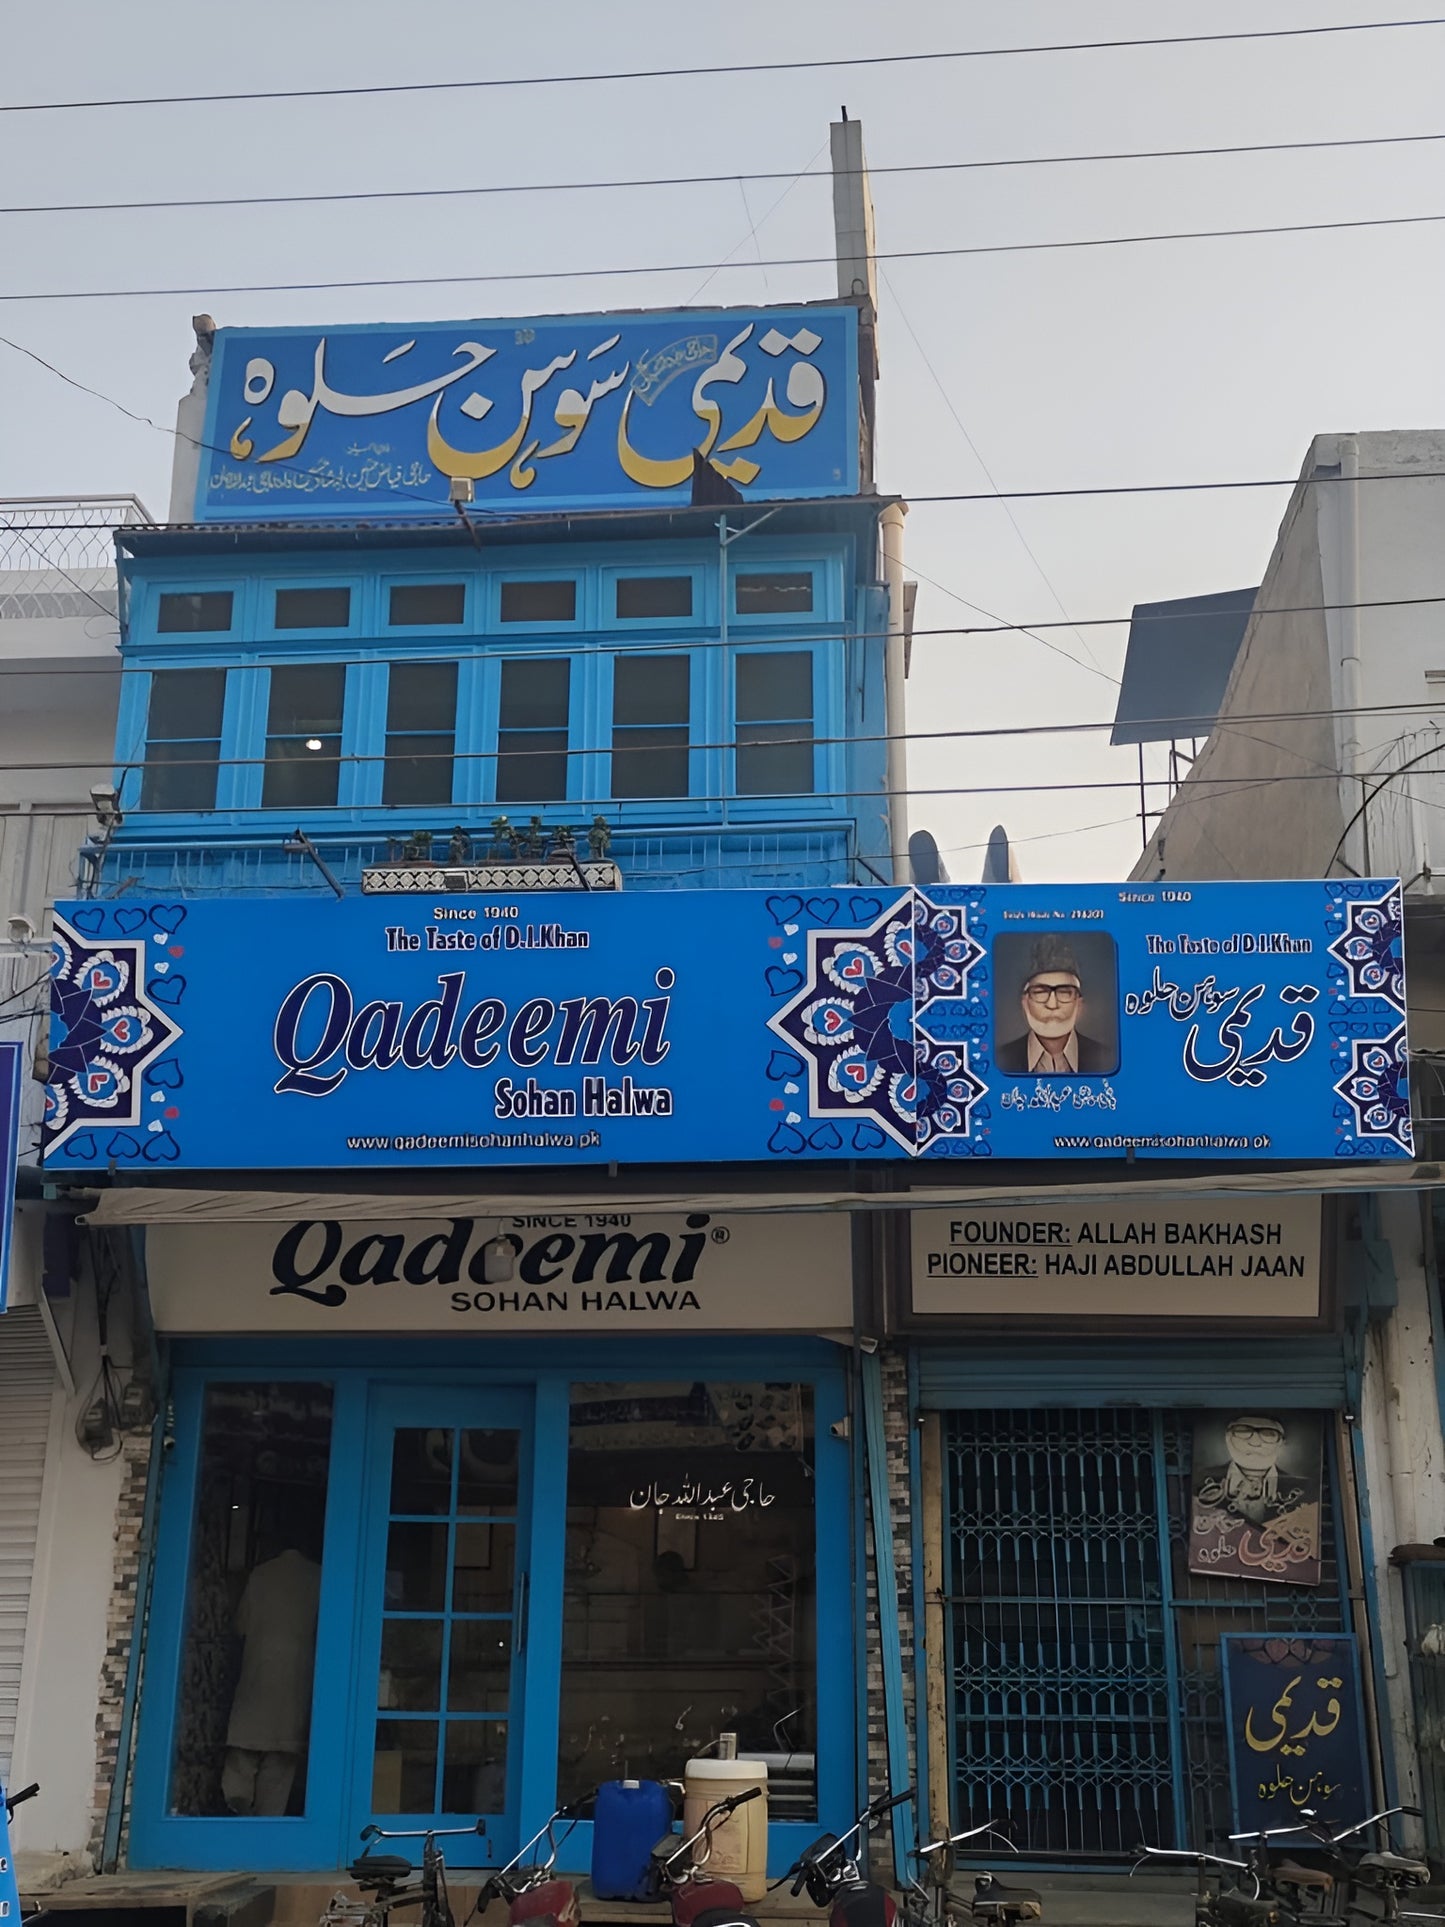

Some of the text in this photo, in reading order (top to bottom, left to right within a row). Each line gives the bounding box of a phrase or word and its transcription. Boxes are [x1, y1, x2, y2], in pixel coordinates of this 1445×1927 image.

[618, 322, 824, 489] قدیمی
[433, 906, 519, 919] Since 1940
[385, 924, 590, 951] The Taste of D.I.Khan
[1146, 934, 1175, 954] The
[1178, 934, 1220, 954] Taste
[1222, 934, 1239, 954] of
[1125, 966, 1179, 1015] حلوہ
[273, 967, 676, 1097] Qadeemi
[1183, 983, 1321, 1088] قدیمی
[494, 1076, 673, 1119] Sohan Halwa
[512, 1213, 631, 1228] SINCE 1940
[949, 1221, 1282, 1246] FOUNDER: ALLAH BAKHASH
[927, 1253, 1305, 1278] PIONEER: HAJI ABDULLAH JAAN
[450, 1291, 701, 1312] SOHAN HALWA
[629, 1473, 776, 1515] حاجی عبداللہ جان
[1244, 1675, 1343, 1757] قدیمی
[1257, 1763, 1294, 1800] حلوہ
